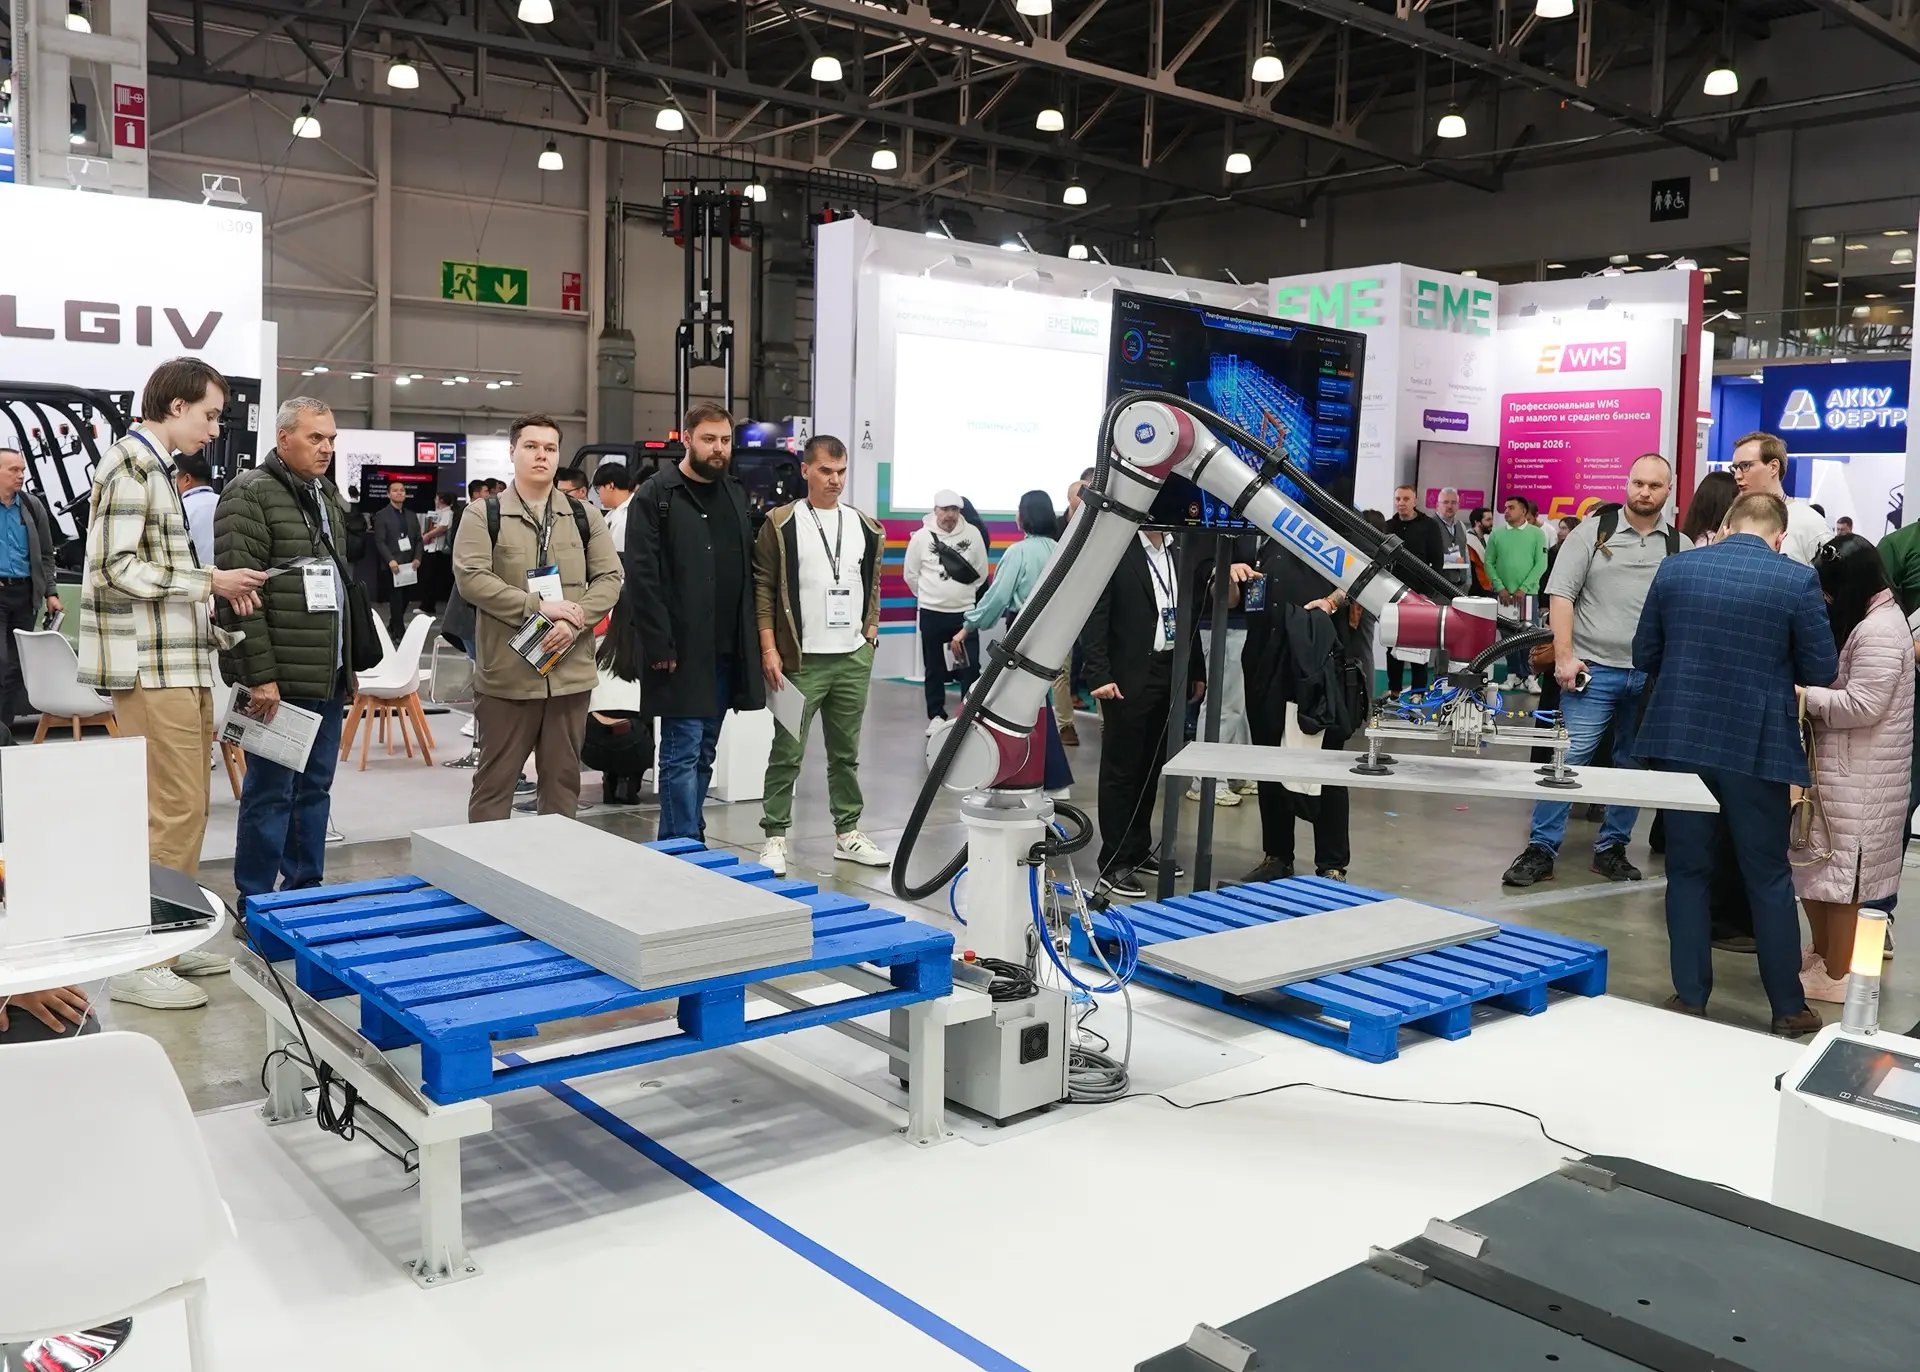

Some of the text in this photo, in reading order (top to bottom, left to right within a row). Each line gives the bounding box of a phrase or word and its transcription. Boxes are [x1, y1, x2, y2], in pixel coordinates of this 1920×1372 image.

[1417, 279, 1492, 336] EME
[1567, 346, 1622, 368] WMS
[1509, 399, 1620, 413] Профессиональная WMS
[1826, 387, 1892, 408] АККУ
[1508, 411, 1651, 424] для малого и среднего бизнеса
[1826, 408, 1908, 429] ФЕРТР
[861, 442, 874, 451] 409
[1508, 439, 1572, 452] Прорыв 2026 г.
